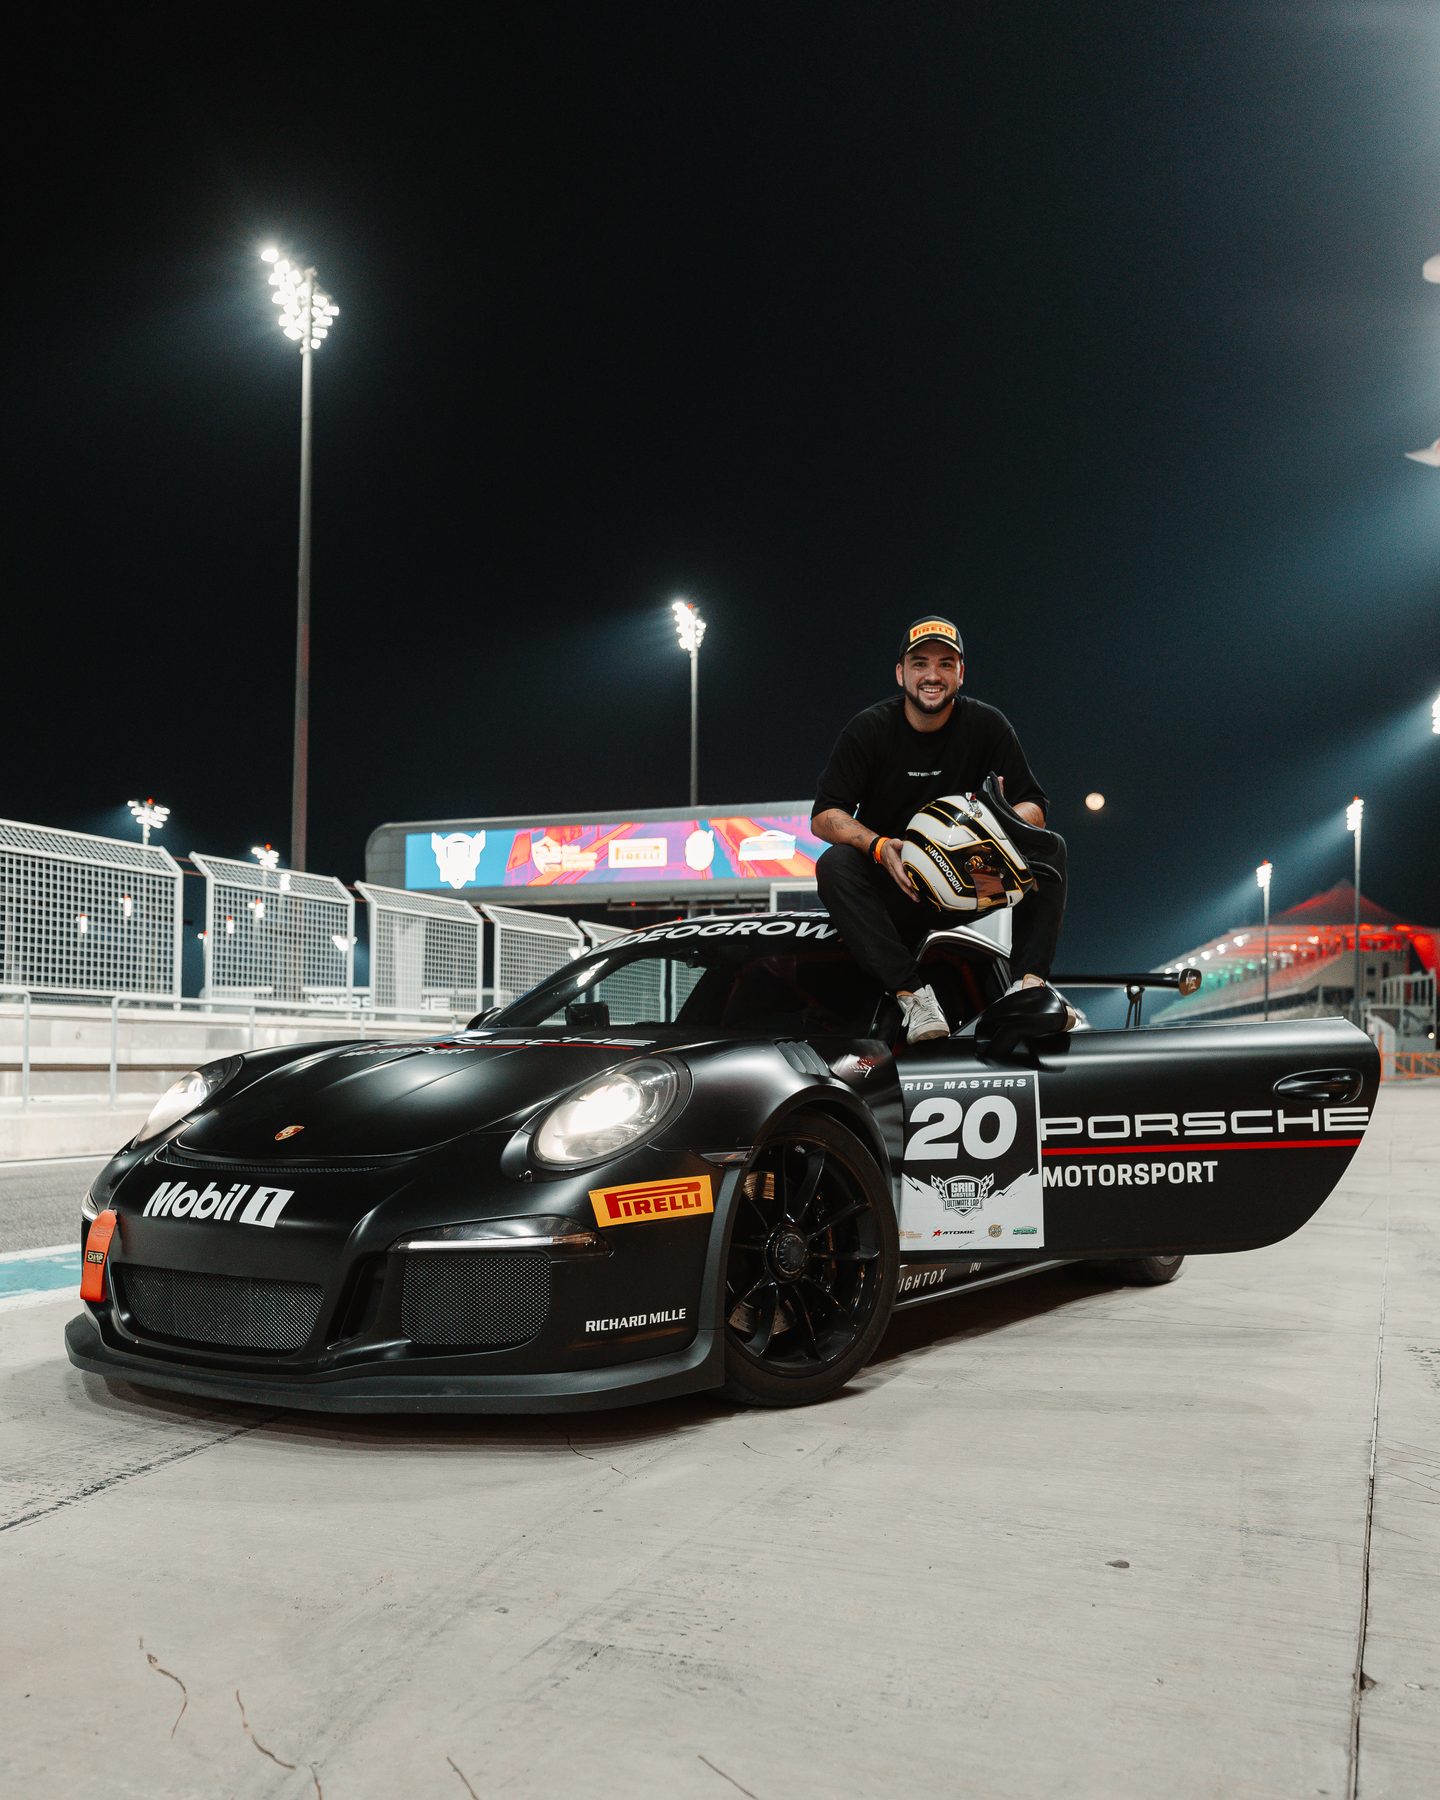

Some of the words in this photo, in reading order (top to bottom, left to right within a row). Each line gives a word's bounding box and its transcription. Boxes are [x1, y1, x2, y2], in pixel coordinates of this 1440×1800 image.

[912, 624, 953, 638] PIRELLI
[924, 843, 963, 893] VIDEOGROWN
[943, 1078, 1027, 1090] MASTERS
[903, 1095, 1018, 1161] 20
[1040, 1106, 1369, 1141] PORSCHE
[951, 1182, 975, 1193] GRID
[1042, 1160, 1219, 1188] MOTORSPORT
[142, 1181, 251, 1222] Mobil
[603, 1181, 702, 1219] PIRELLI
[946, 1200, 970, 1208] ULTIMATE
[897, 1268, 947, 1294] IGHTOX
[585, 1314, 647, 1333] RICHARD
[649, 1308, 687, 1325] MILLE
